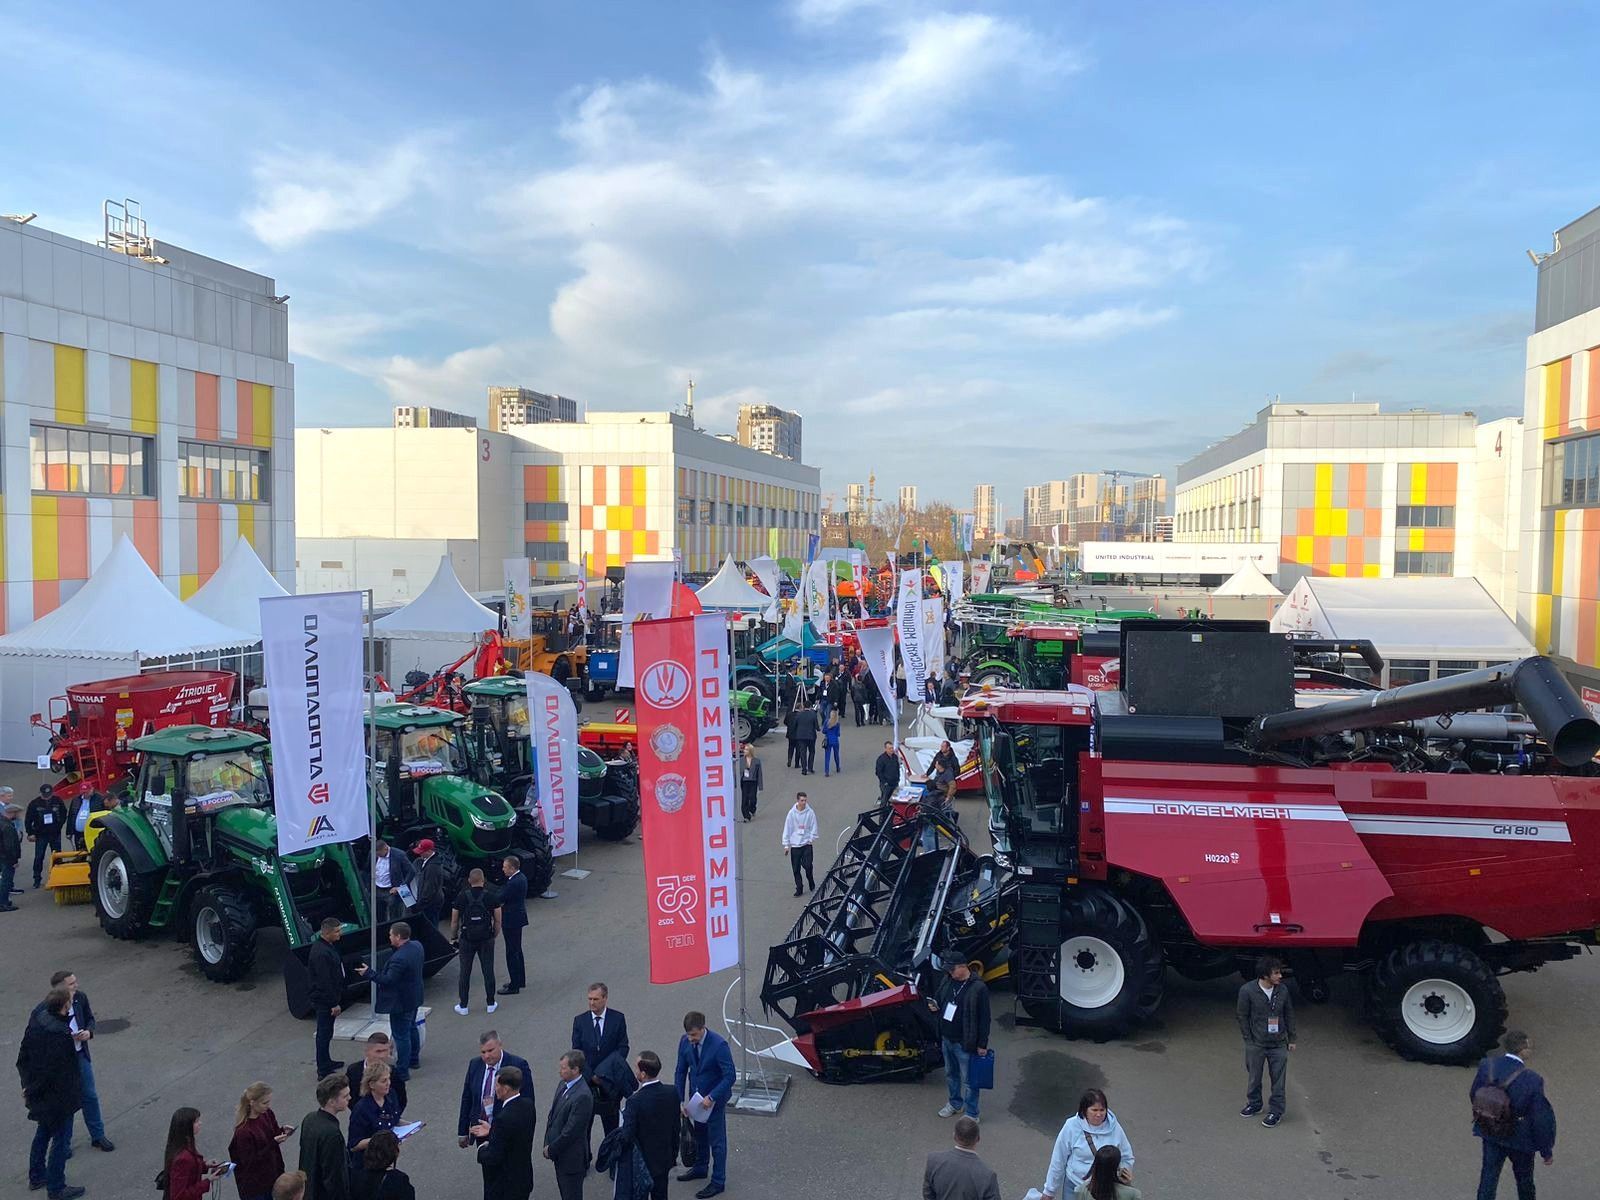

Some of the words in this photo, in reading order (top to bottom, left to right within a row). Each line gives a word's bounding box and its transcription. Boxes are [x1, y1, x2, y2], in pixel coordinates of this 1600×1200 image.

[482, 438, 491, 462] 3
[1495, 430, 1503, 458] 4
[72, 695, 106, 703] КОЛНАГ
[1153, 803, 1291, 820] GOMSELMASH
[1493, 826, 1512, 835] GH
[1514, 826, 1539, 836] 810
[1205, 853, 1230, 863] H0220
